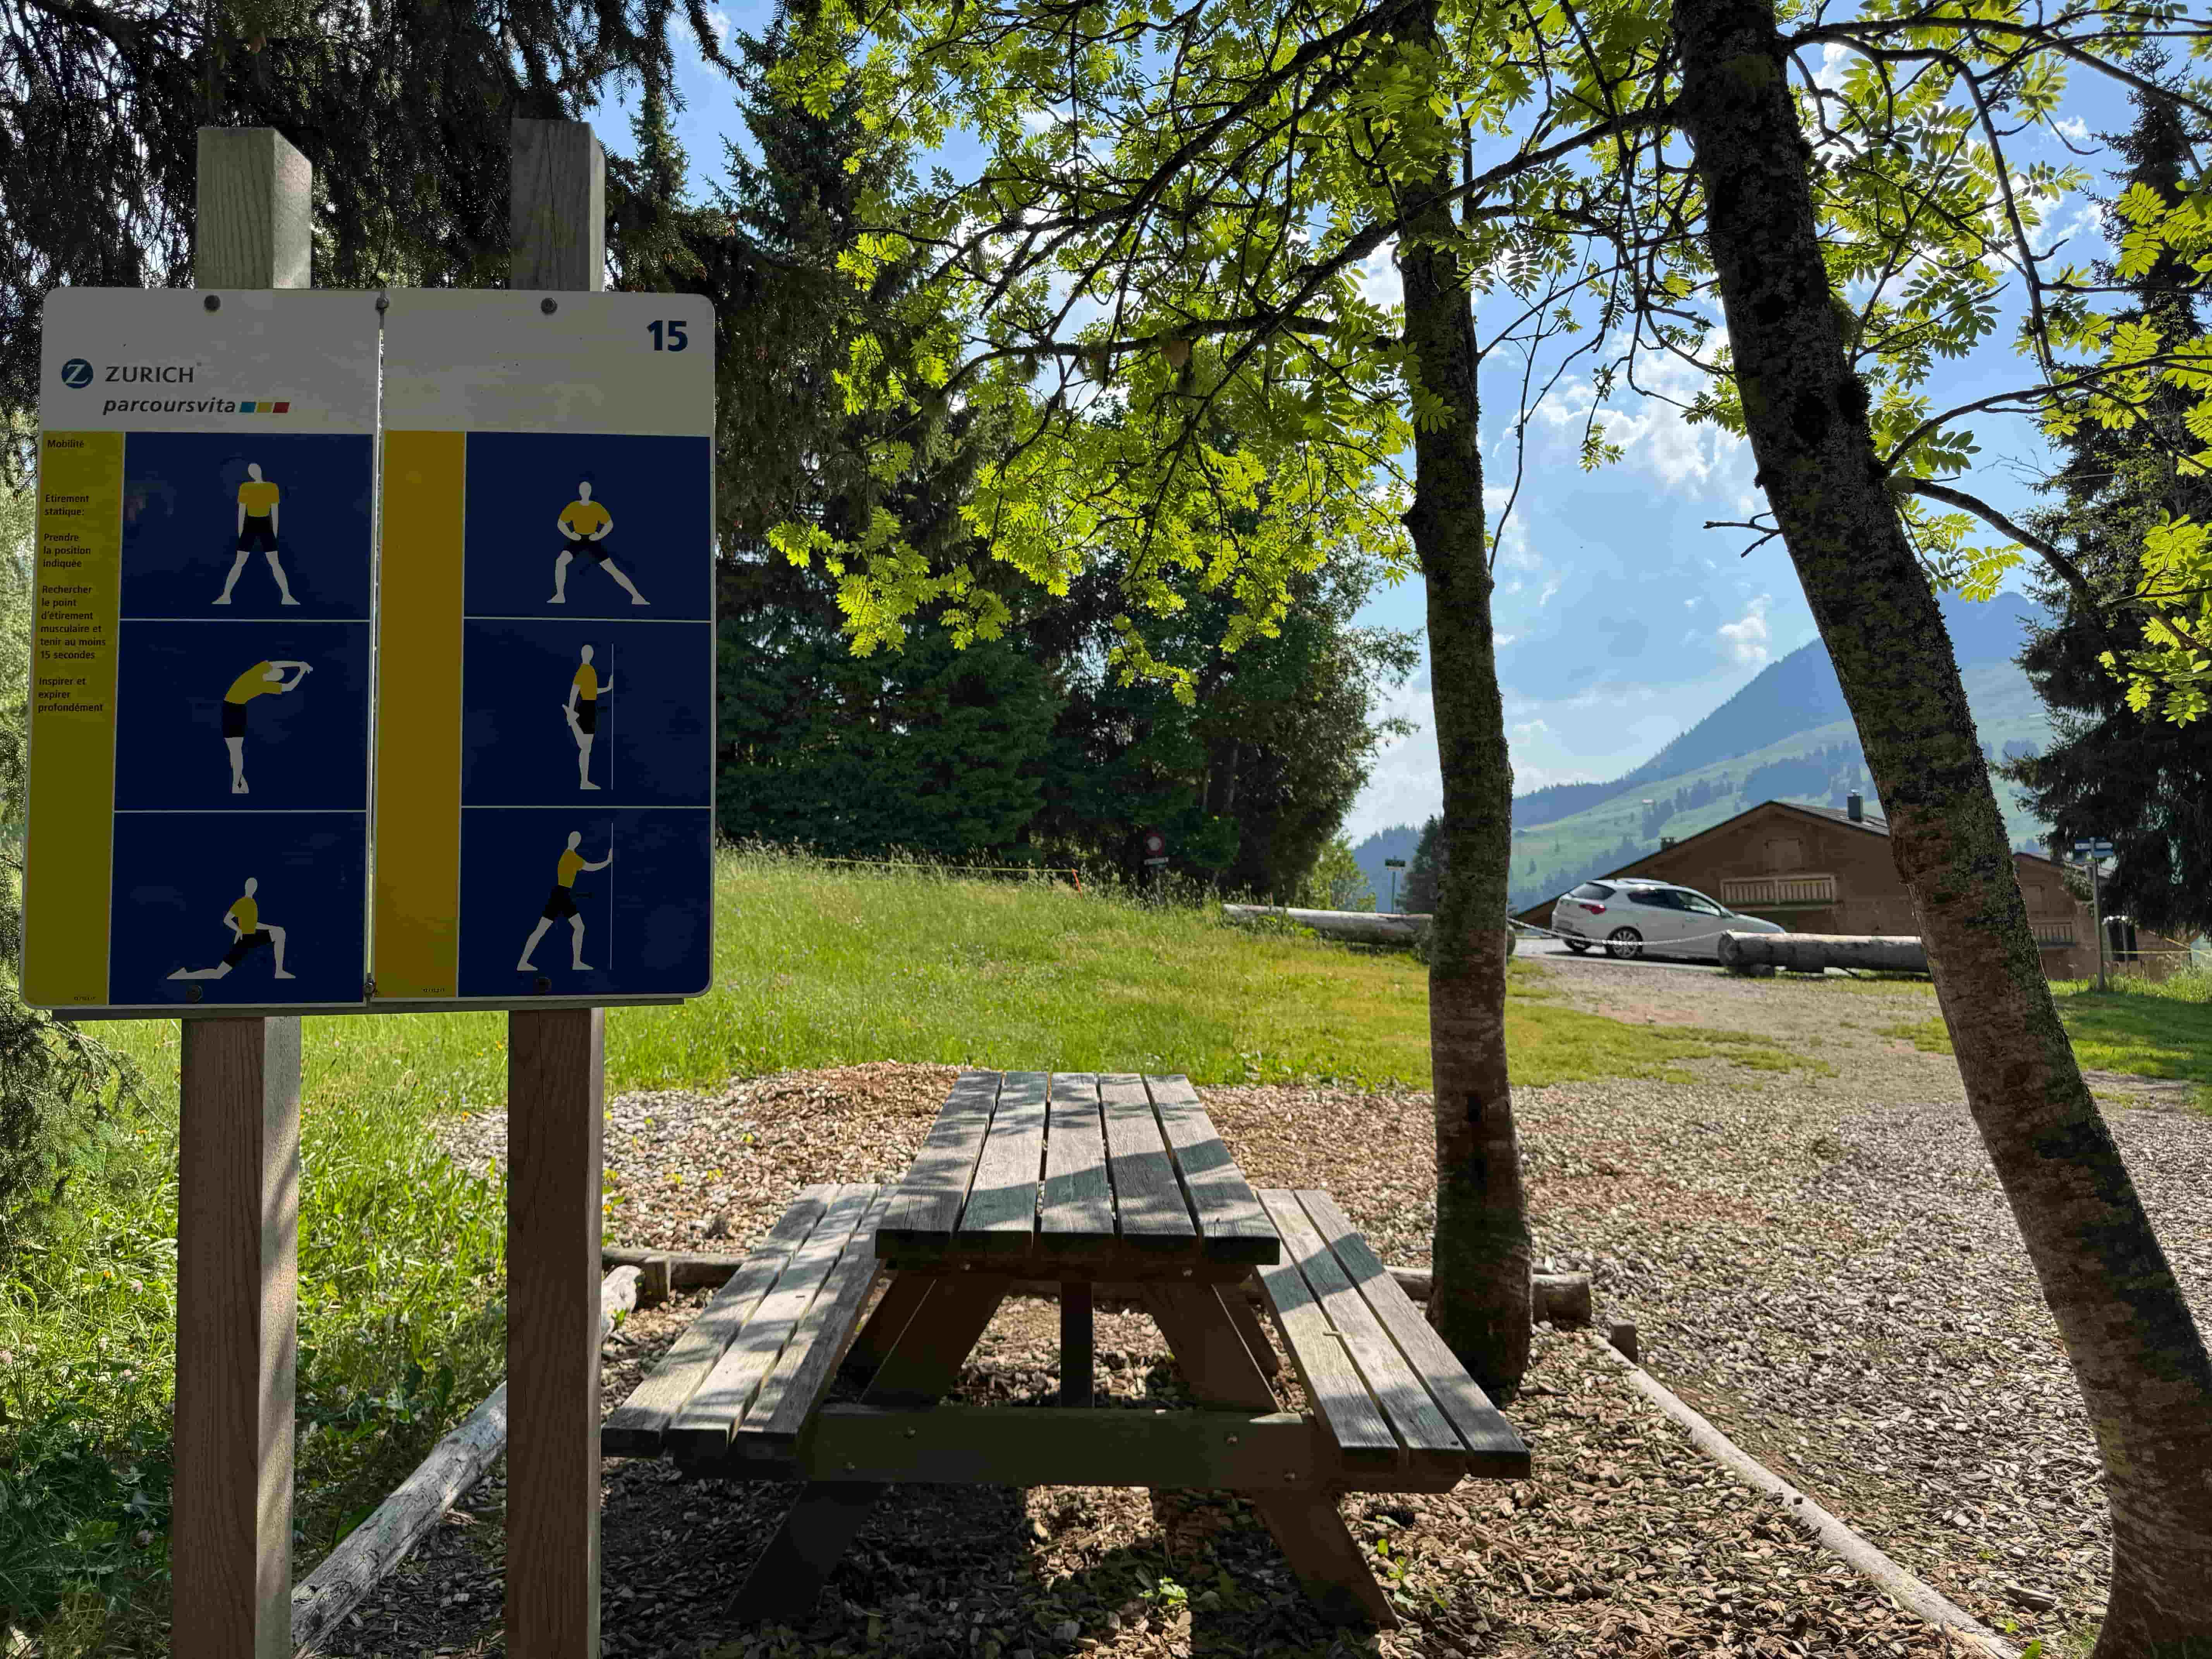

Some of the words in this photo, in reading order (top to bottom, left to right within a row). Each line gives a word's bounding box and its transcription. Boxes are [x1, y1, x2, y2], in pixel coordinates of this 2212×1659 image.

[646, 320, 688, 352] 15
[105, 366, 194, 383] ZURICH
[103, 397, 236, 415] parcoursvita
[47, 440, 84, 448] Mobilité
[45, 494, 89, 503] Etirement
[44, 507, 84, 517] statique:
[43, 533, 79, 542] Prendre
[43, 546, 51, 555] la
[55, 546, 91, 556] position
[43, 560, 82, 570] indiquée
[42, 585, 93, 594] Rechercher
[41, 598, 50, 606] le
[53, 598, 77, 608] point
[41, 611, 94, 620] d'étirement
[40, 624, 90, 633] musculaire
[93, 625, 102, 633] et
[40, 637, 62, 646] tenir
[79, 637, 106, 646] moins
[40, 650, 50, 659] 15
[53, 650, 95, 659] secondes
[39, 677, 74, 687] Inspirer
[38, 690, 71, 700] expirer
[38, 703, 104, 714] profondément
